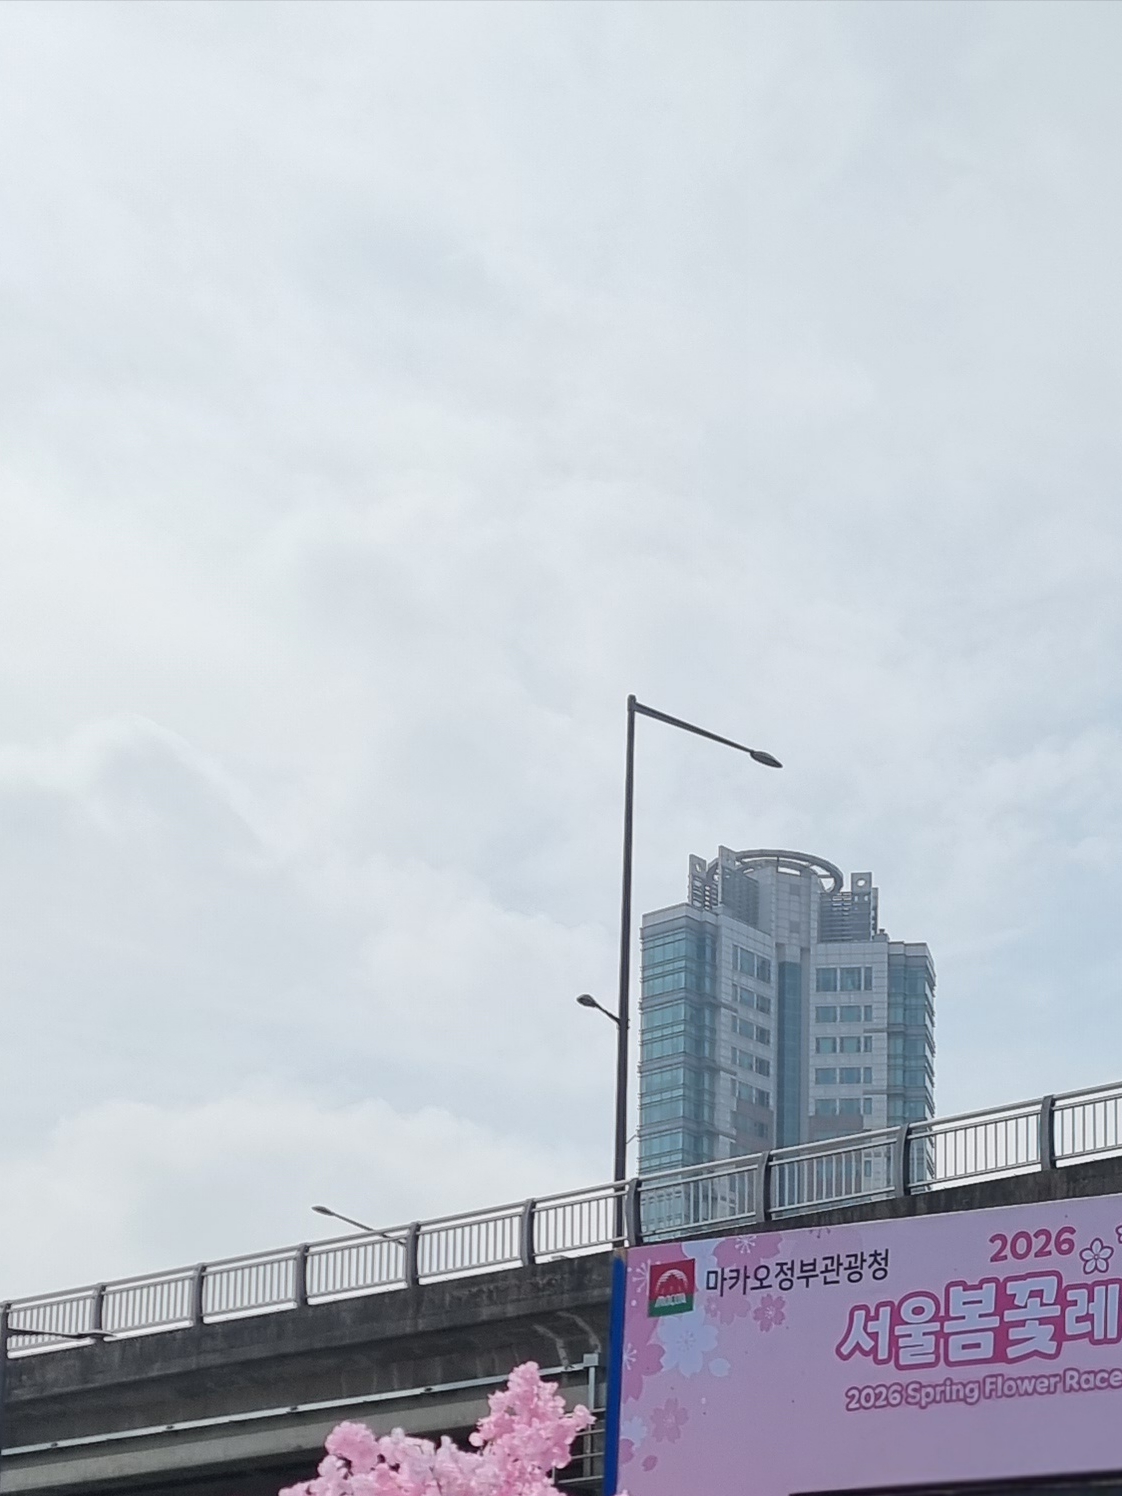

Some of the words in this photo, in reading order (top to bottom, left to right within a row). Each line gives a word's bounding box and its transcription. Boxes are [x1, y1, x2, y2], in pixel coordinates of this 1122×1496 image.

[989, 1226, 1077, 1263] 2026
[705, 1248, 890, 1297] 마카오정부관광청
[846, 1384, 903, 1411] 2026
[904, 1377, 981, 1409] Spring
[983, 1373, 1060, 1400] Flower
